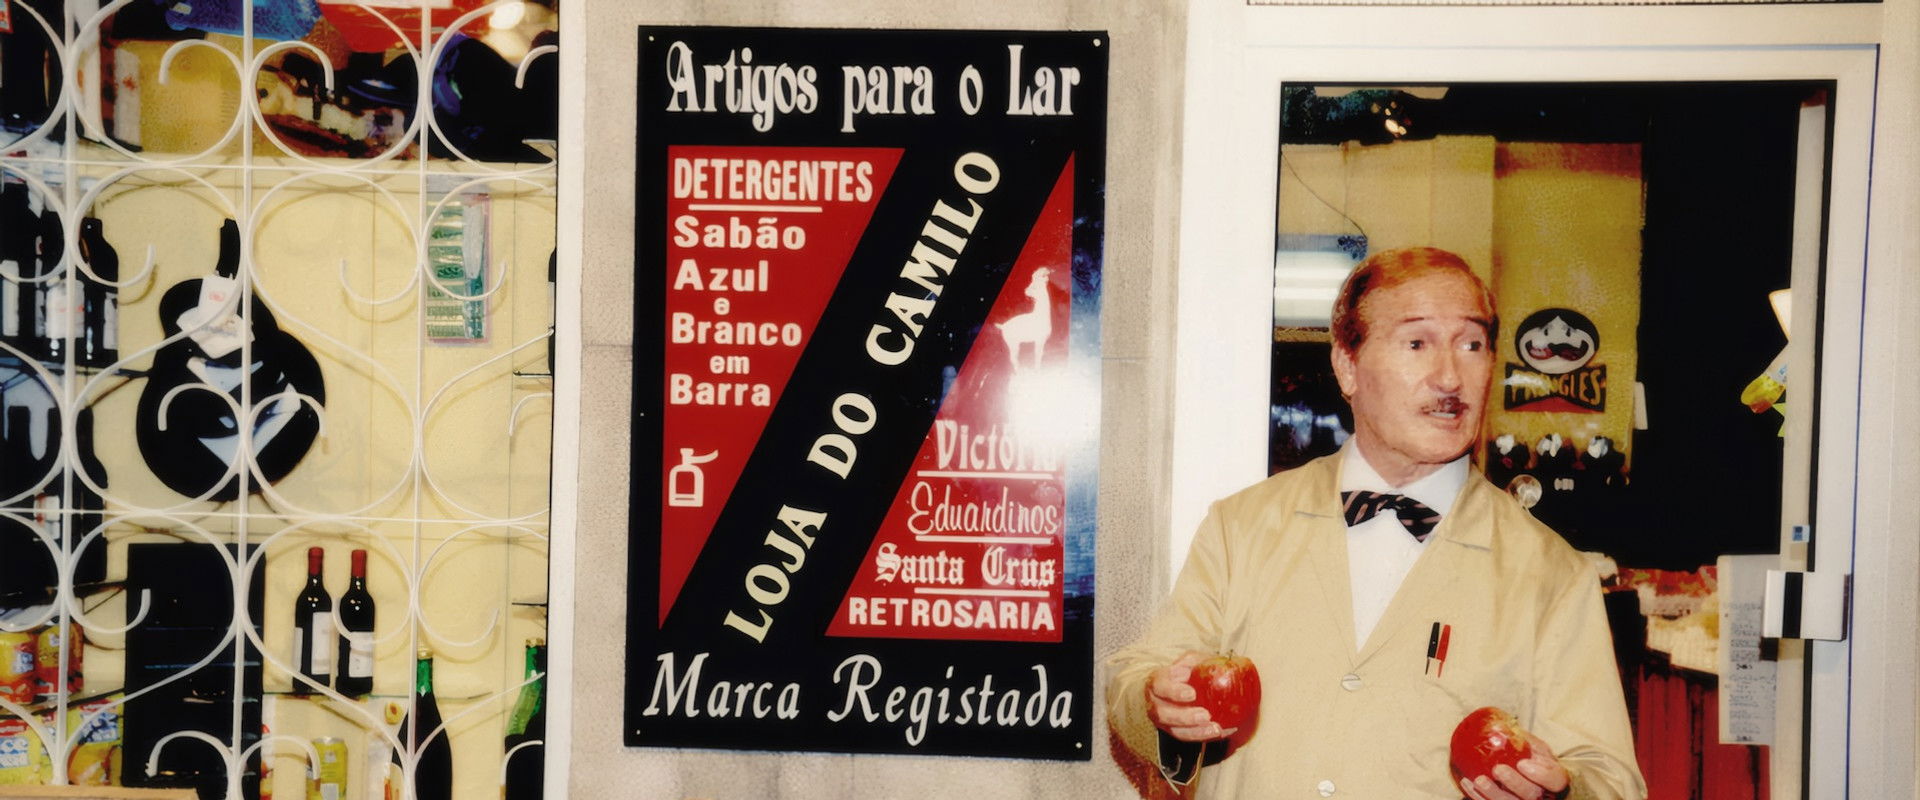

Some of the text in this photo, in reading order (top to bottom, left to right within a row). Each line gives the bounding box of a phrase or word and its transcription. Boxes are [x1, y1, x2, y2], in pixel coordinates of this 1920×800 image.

[667, 41, 1080, 132] Artigos para o Lar
[674, 158, 873, 202] DETERGENTES
[673, 215, 806, 250] Sabão
[673, 258, 769, 292] Azul
[713, 297, 730, 315] e
[671, 312, 802, 346] Branco
[710, 355, 750, 374] em
[669, 373, 771, 406] Barra
[723, 151, 1001, 644] LOJA DO CAMILO
[907, 481, 1057, 535] Eduardinos
[875, 543, 964, 584] Santa
[849, 597, 1055, 631] RETROSARIA
[642, 652, 1072, 746] Marca Registada
